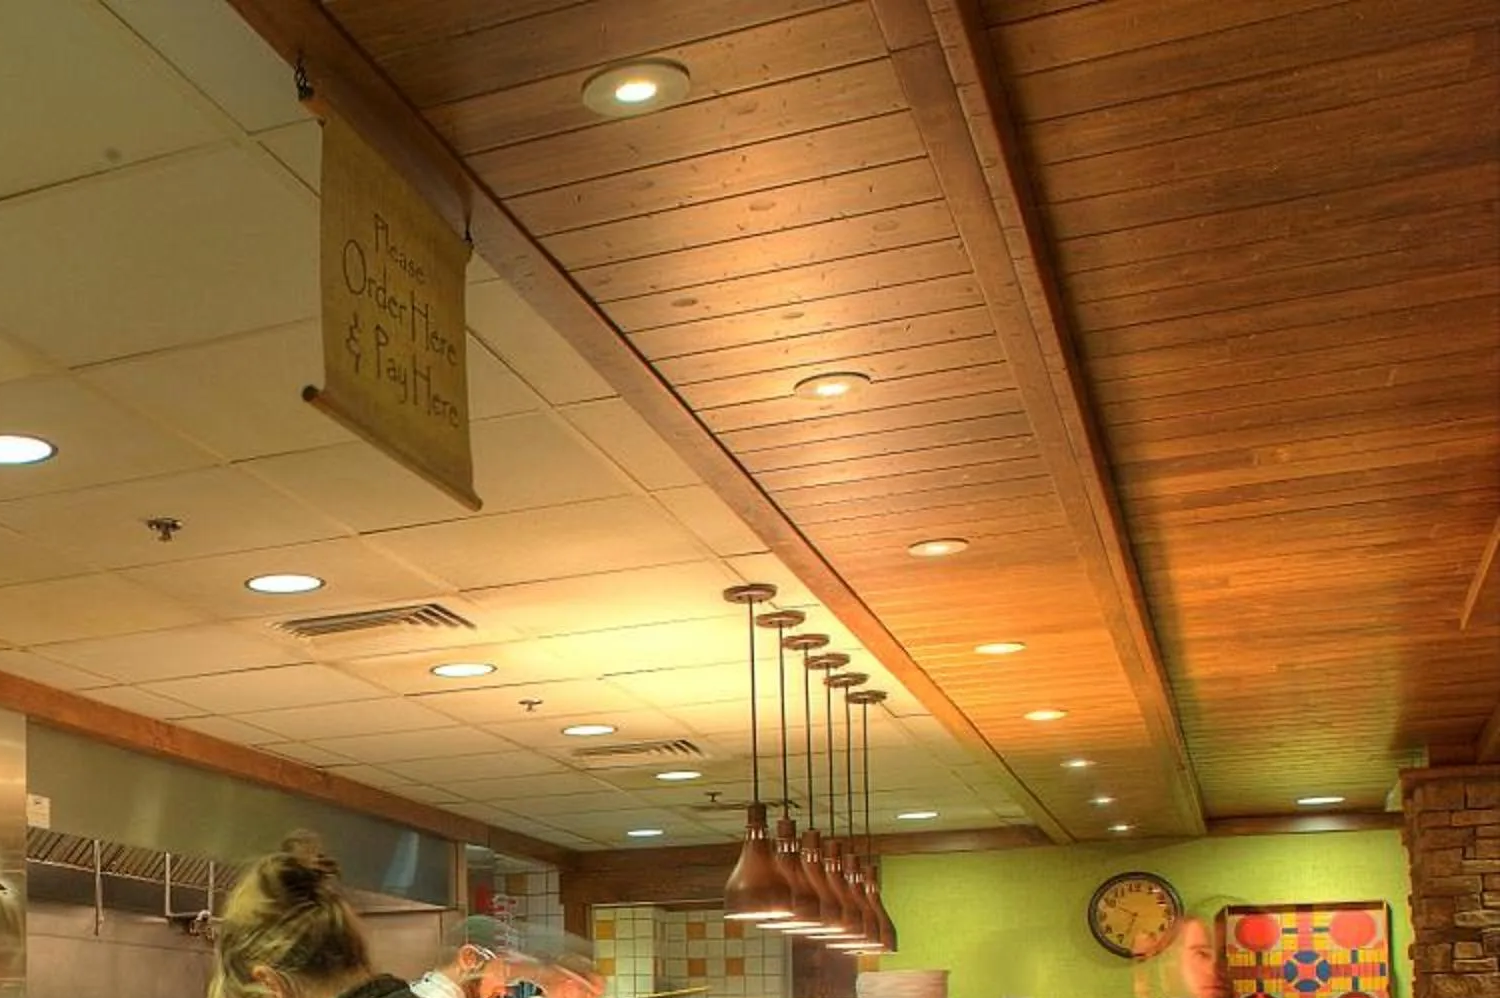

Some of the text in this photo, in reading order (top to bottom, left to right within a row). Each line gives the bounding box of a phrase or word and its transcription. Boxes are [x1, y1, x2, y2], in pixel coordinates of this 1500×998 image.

[373, 212, 426, 285] Please
[342, 239, 458, 367] Order Here
[375, 324, 408, 404] Pay
[411, 354, 460, 429] Here
